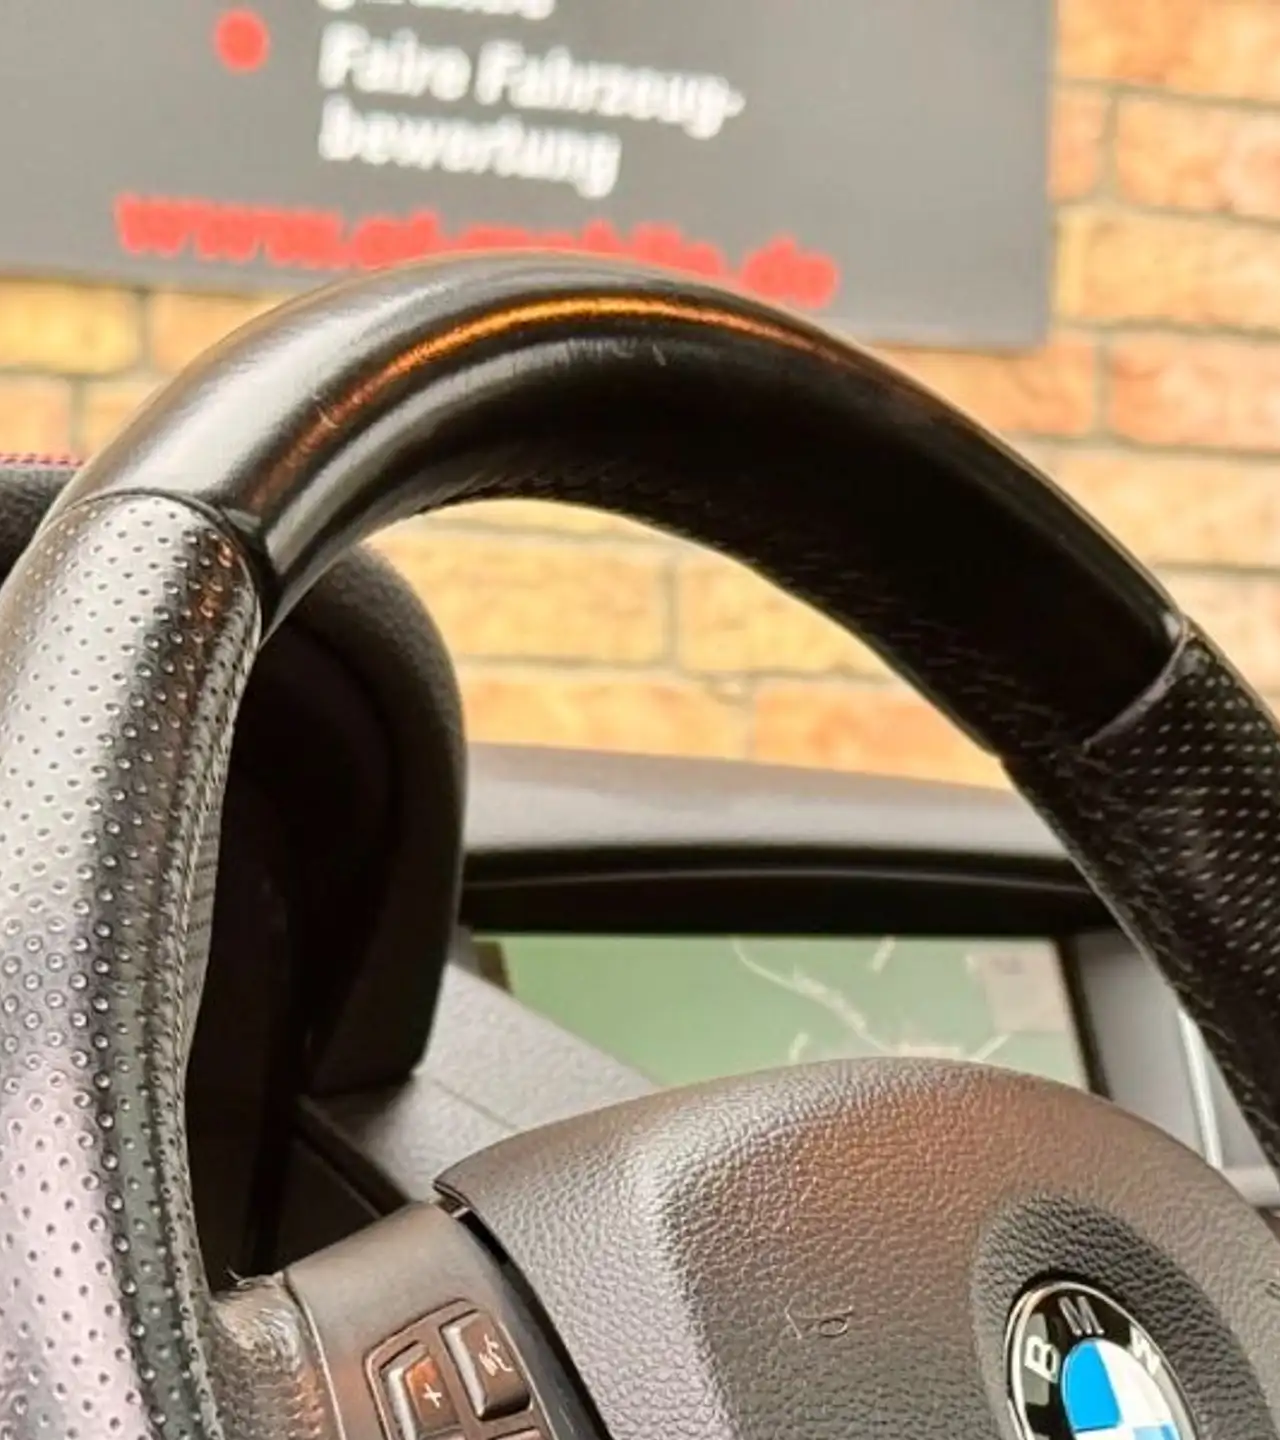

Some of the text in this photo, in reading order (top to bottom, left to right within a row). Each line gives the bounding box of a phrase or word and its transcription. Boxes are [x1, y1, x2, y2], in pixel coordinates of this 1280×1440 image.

[319, 20, 746, 139] Faire Fahrzeug-
[1024, 1295, 1161, 1385] BMW
